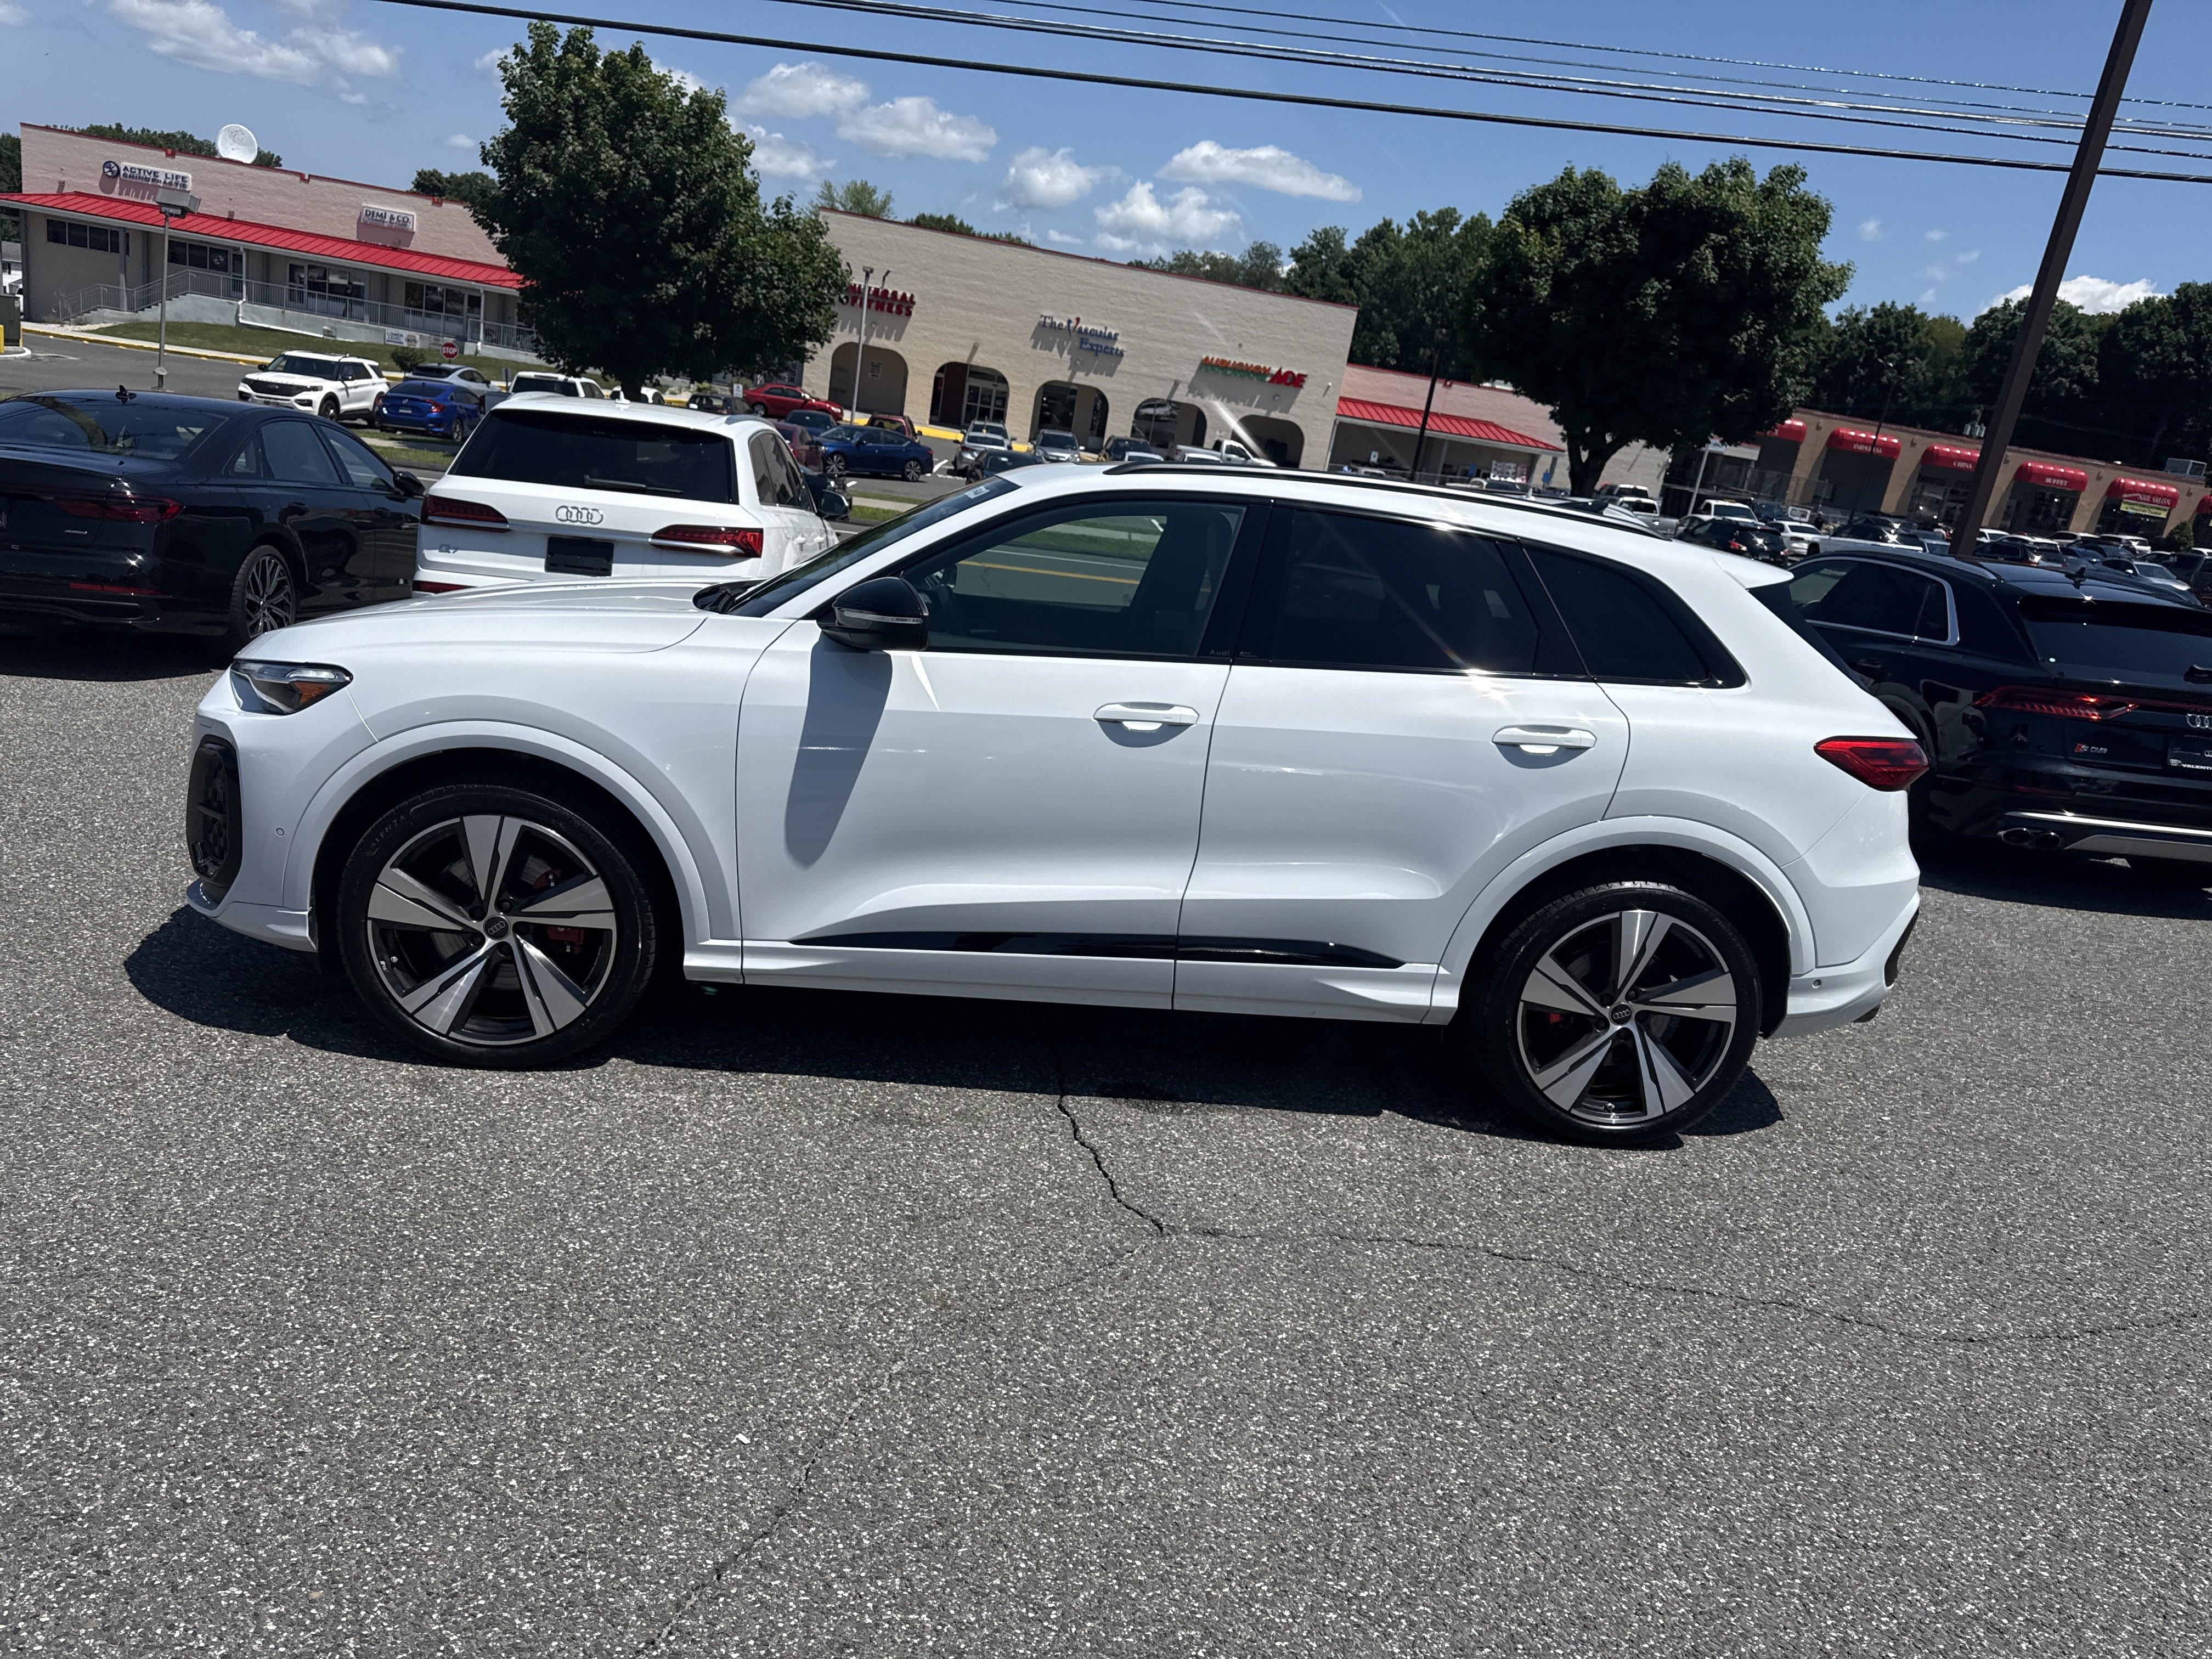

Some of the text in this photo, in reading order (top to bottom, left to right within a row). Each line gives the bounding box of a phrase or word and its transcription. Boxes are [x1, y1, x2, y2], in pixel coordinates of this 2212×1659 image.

[122, 166, 188, 183] ACTIVE LIFE
[122, 172, 188, 189] CHIROPRACTIC
[851, 296, 913, 317] FITNESS
[1040, 314, 1120, 341] The Vascular
[442, 347, 458, 355] STOP
[1079, 337, 1125, 357] Experts
[1202, 356, 1271, 375] AUBUCHON
[1268, 366, 1308, 389] ACE
[1953, 461, 1972, 469] CHINA
[2045, 477, 2068, 486] BUFFET
[2152, 496, 2172, 505] SALON
[439, 544, 460, 554] Q7
